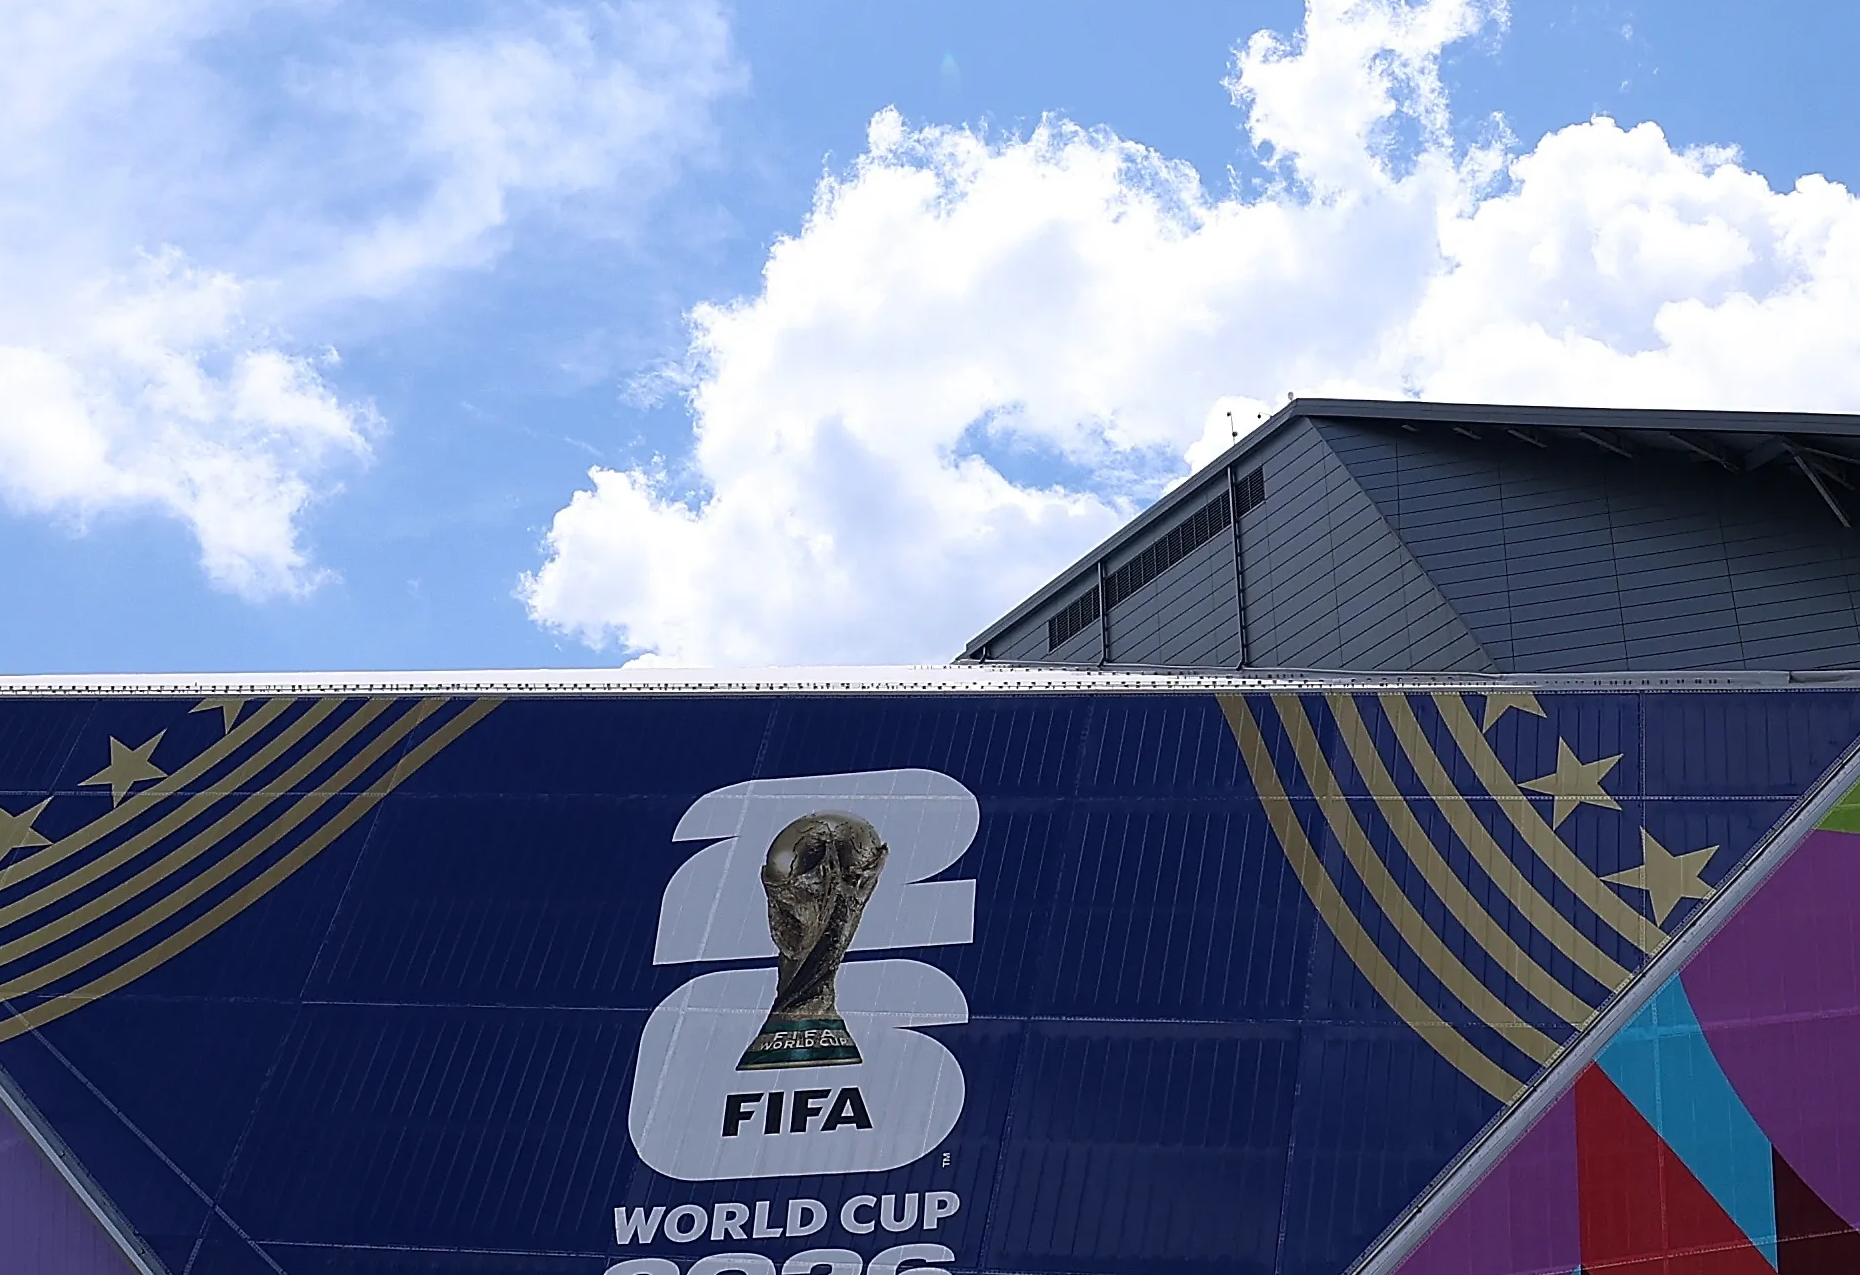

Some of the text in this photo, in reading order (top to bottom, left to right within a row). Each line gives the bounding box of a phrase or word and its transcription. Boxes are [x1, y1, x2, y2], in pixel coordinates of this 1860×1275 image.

[761, 1038, 847, 1050] WORLD CUP
[773, 1029, 835, 1041] FIFA
[721, 1086, 873, 1138] FIFA
[614, 1191, 961, 1245] WORLD CUP
